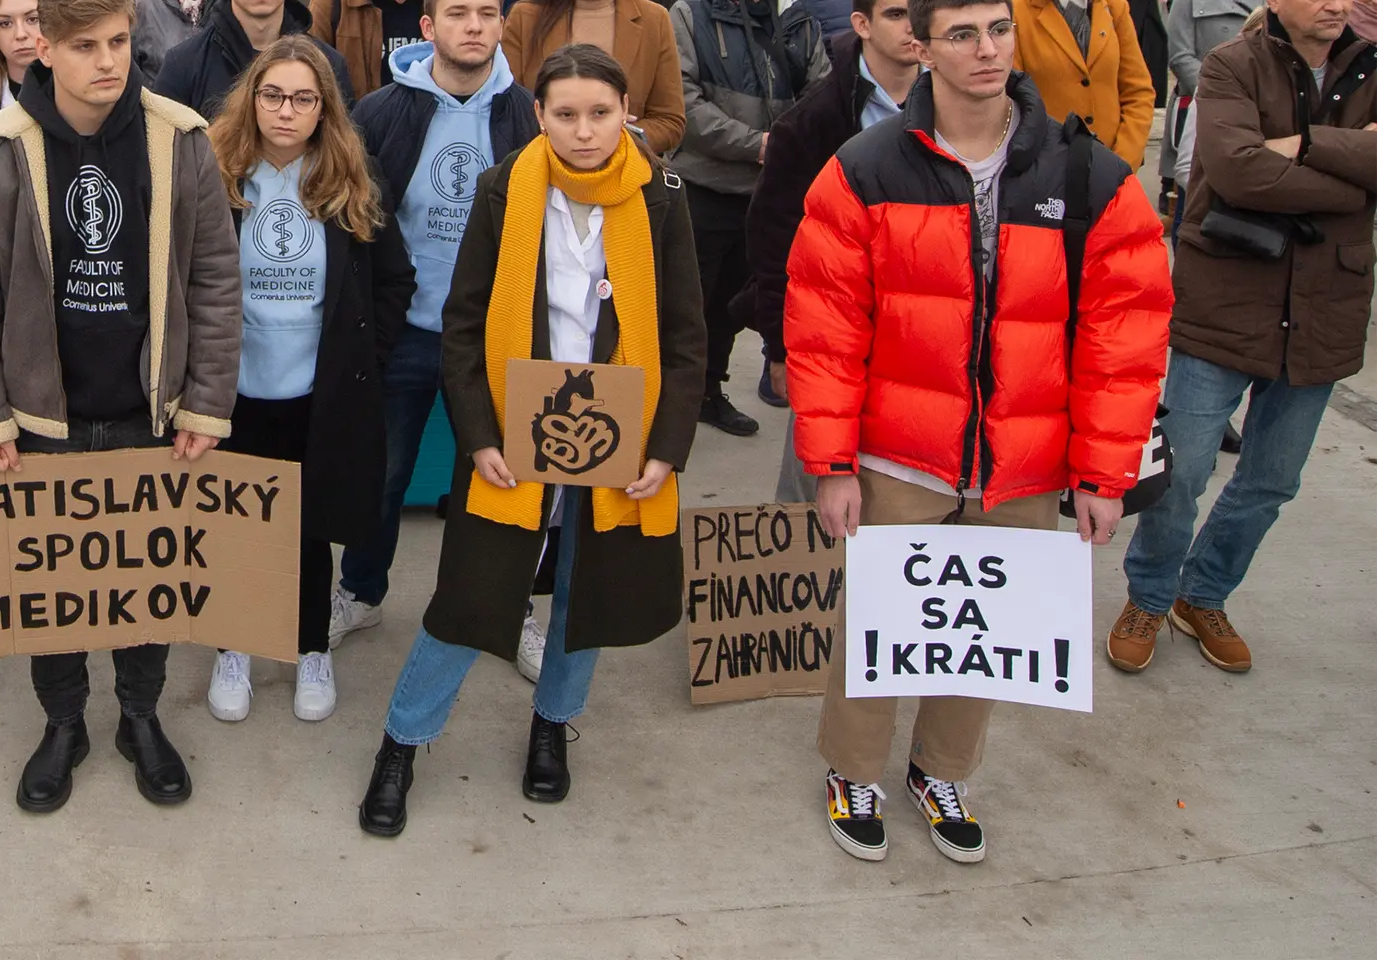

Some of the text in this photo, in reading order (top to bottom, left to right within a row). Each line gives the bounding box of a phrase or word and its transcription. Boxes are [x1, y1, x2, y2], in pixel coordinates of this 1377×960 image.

[428, 207, 469, 218] FACULTY
[249, 267, 316, 278] FACULTY OF
[250, 280, 315, 291] MEDICINE
[250, 292, 316, 302] Comenius University
[15, 525, 207, 572] SPOLOK
[694, 506, 792, 570] PREČO
[904, 543, 1007, 589] ČAS
[921, 597, 989, 631] SA
[692, 622, 835, 687] ZAHRANIČN
